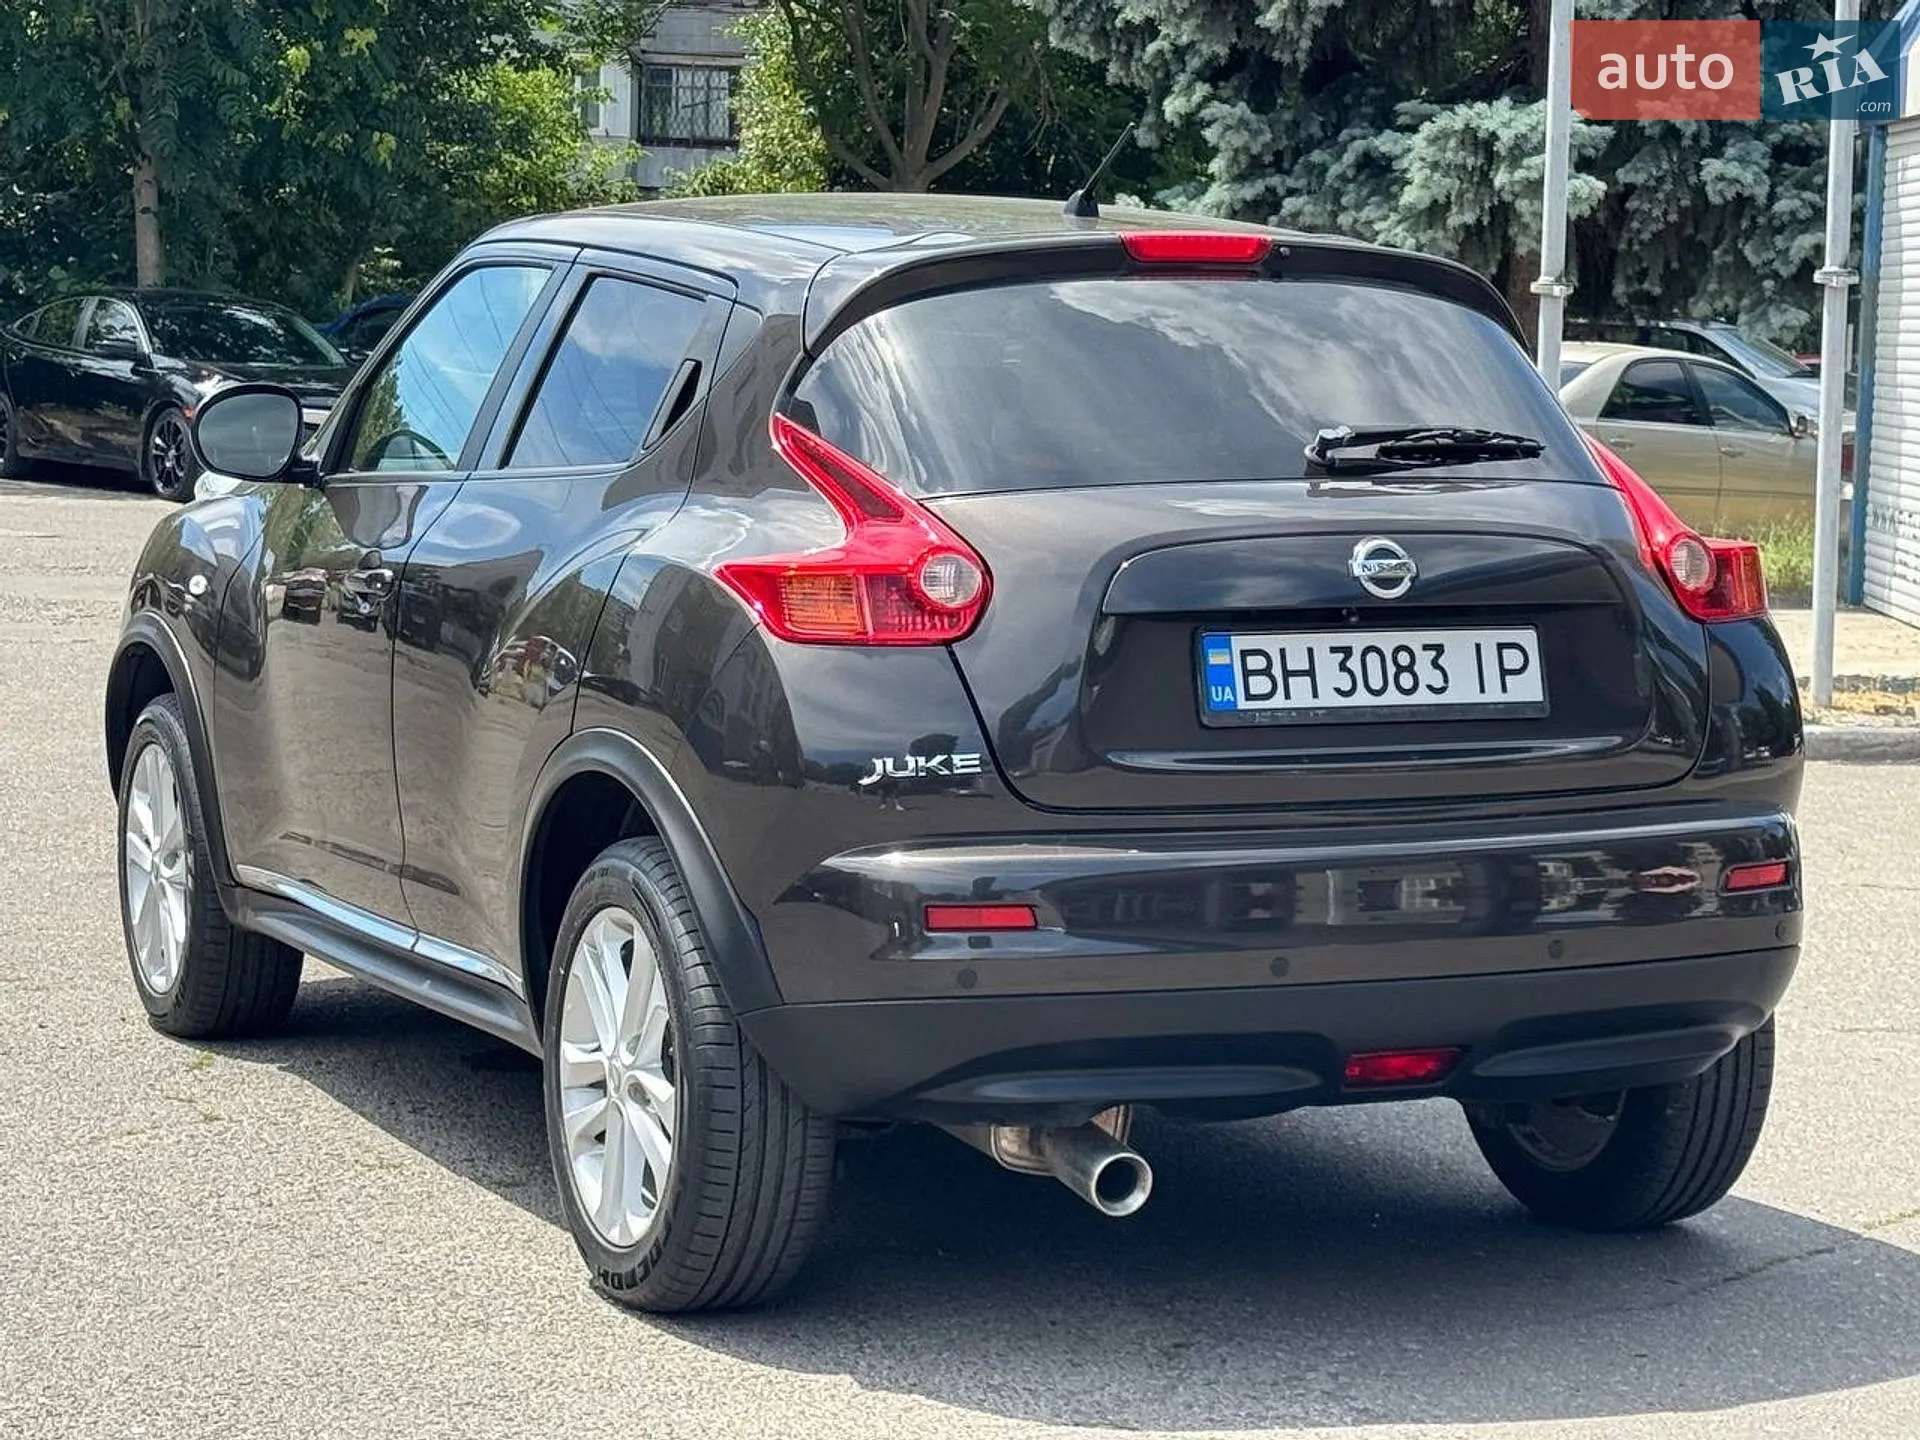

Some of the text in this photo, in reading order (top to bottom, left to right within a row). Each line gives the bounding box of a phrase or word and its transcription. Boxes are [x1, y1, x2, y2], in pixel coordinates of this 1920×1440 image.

[1475, 642, 1530, 694] IP
[1211, 686, 1235, 702] UA
[858, 753, 982, 786] JUKE
